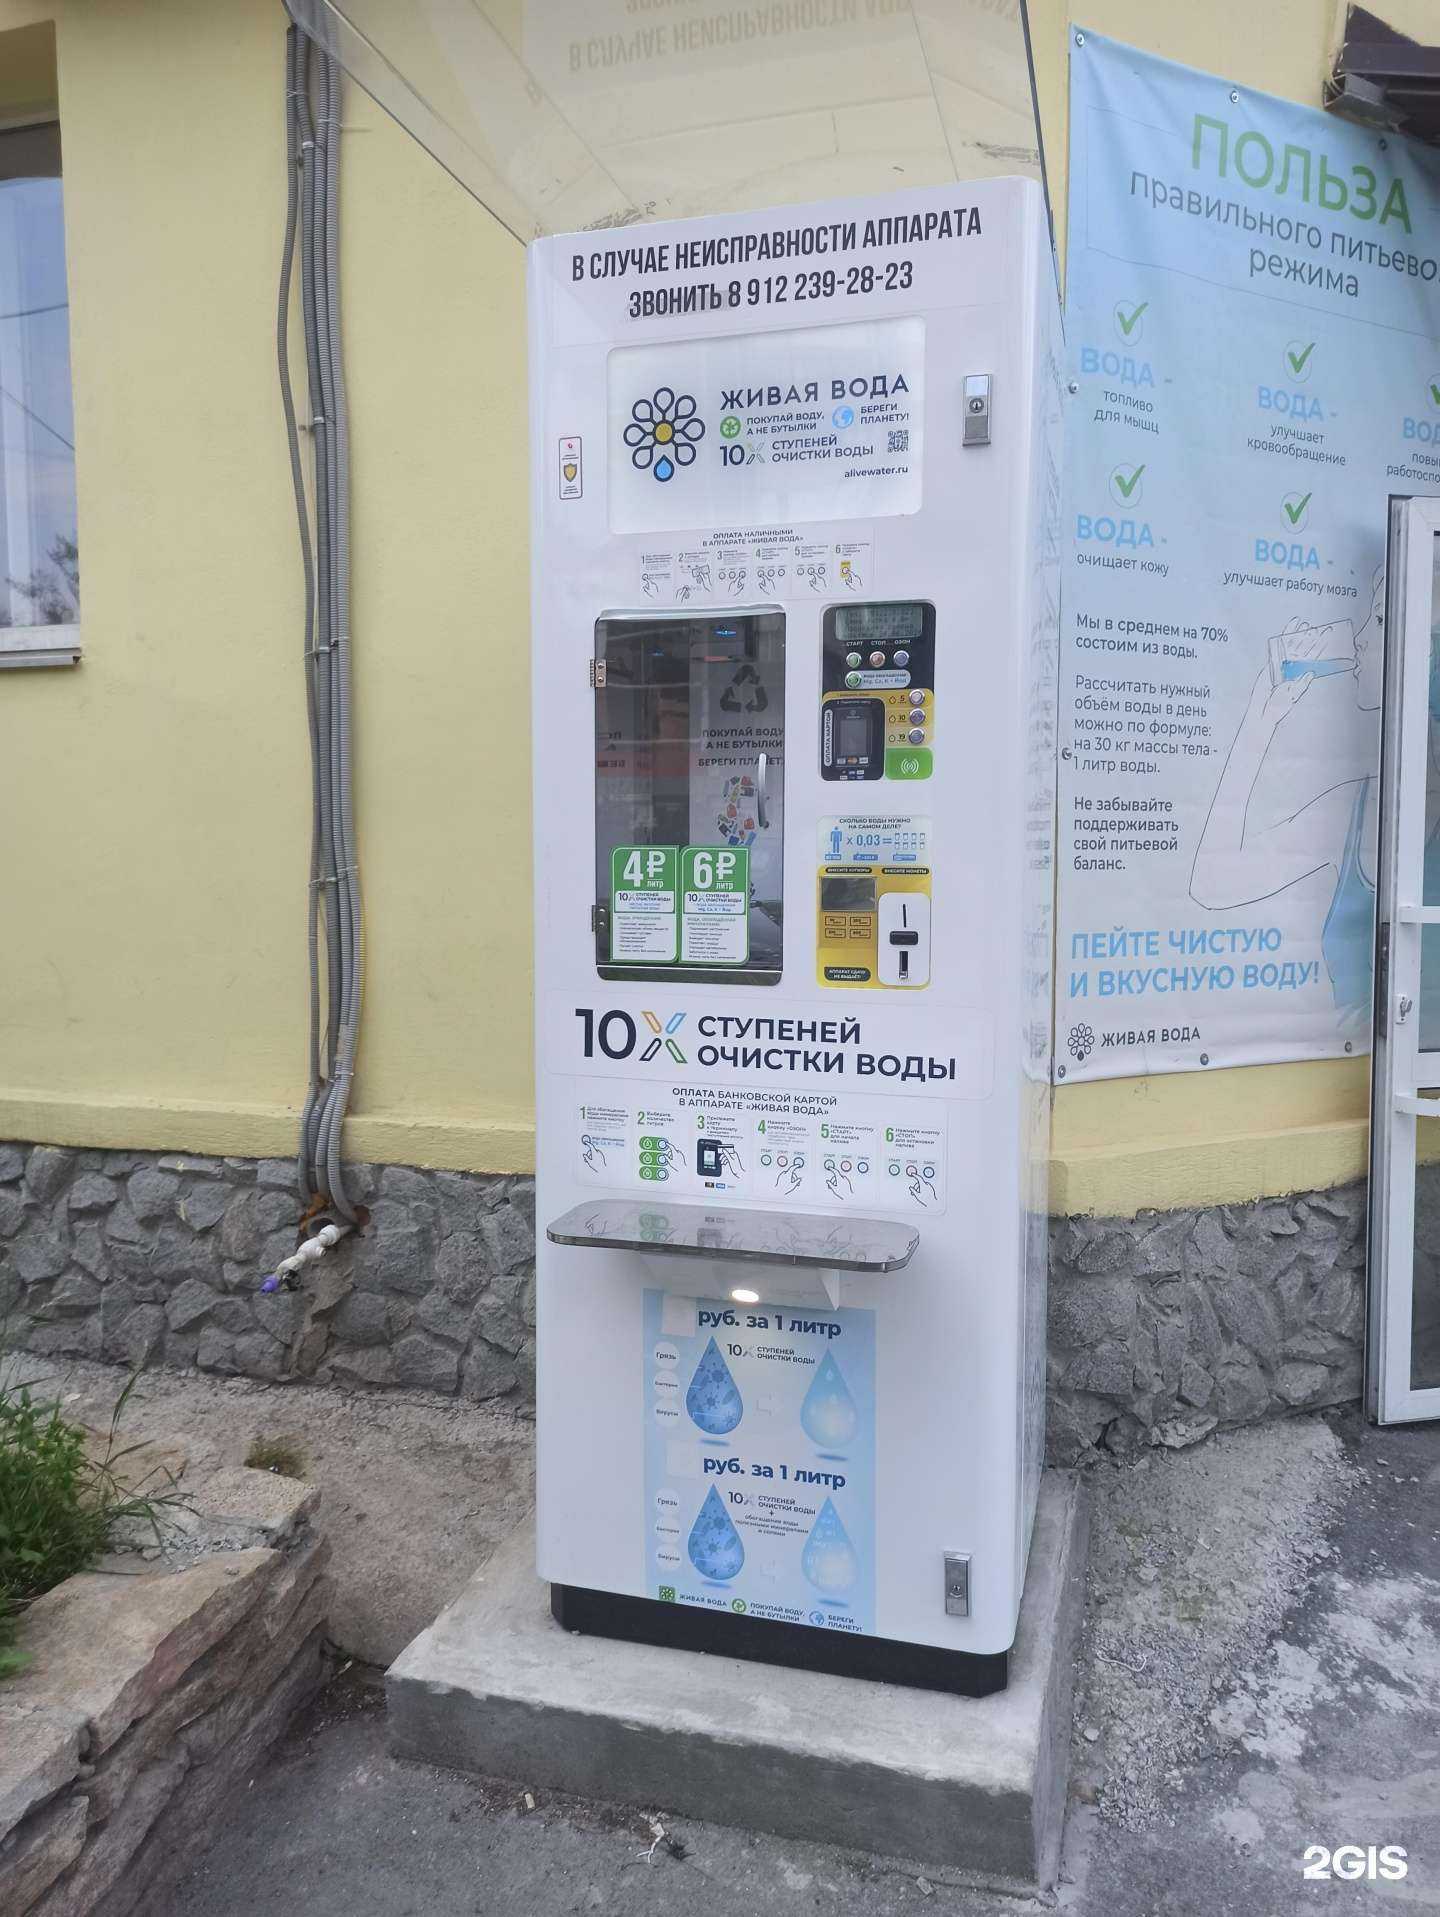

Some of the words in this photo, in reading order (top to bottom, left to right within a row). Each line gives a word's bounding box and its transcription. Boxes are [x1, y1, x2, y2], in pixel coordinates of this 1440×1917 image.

[1192, 113, 1412, 234] ПОЛЬЗА
[1131, 171, 1322, 249] правильного
[1331, 232, 1440, 282] питьево
[572, 254, 585, 282] В
[590, 244, 669, 279] СЛУЧАЕ
[675, 222, 857, 270] НЕИСПРАВНОСТИ
[862, 206, 982, 249] АППАРАТА
[1250, 248, 1359, 298] режима
[629, 282, 723, 319] ЗВОНИТЬ
[728, 280, 741, 309] 8
[747, 275, 788, 306] 912
[795, 260, 913, 302] 239-28-23
[1081, 347, 1155, 388] ВОДА
[720, 382, 818, 411] ЖИВАЯ
[832, 374, 910, 400] ВОДА
[860, 402, 898, 413] БЕРЕГИ
[1103, 390, 1153, 413] топливо
[1258, 386, 1324, 422] ВОДА
[747, 413, 794, 426] ПОКУПАЙ
[860, 413, 909, 425] ПЛАНЕТУ!
[1094, 408, 1121, 423] для
[1123, 414, 1159, 435] мышц
[747, 428, 754, 436] А
[756, 426, 768, 434] НЕ
[770, 422, 817, 433] БУТЫЛКИ
[1270, 424, 1326, 445] улучшает
[772, 435, 837, 450] СТУПЕНЕЙ
[772, 450, 832, 463] ОЧИСТКИ
[835, 446, 874, 458] ВОДЫ
[1248, 438, 1346, 466] кровообращение
[1412, 453, 1440, 467] повы
[844, 466, 908, 478] alivewater.ru
[745, 529, 793, 537] НАЛИЧНЫМИ
[1077, 514, 1154, 549] ВОДА
[708, 538, 746, 546] АППАРАТЕ
[1255, 539, 1320, 571] ВОДА
[1077, 551, 1138, 572] очищает
[1140, 560, 1169, 578] кожу
[1223, 570, 1283, 590] улучшает
[1286, 576, 1324, 596] работу
[1327, 584, 1358, 598] мозга
[1077, 613, 1100, 629] Мы
[1105, 618, 1113, 630] в
[1118, 619, 1180, 637] среднем
[1183, 627, 1198, 640] на
[1201, 627, 1228, 642] 70%
[1076, 635, 1138, 652] состоим
[1142, 641, 1159, 654] из
[1163, 644, 1197, 659] воды.
[1076, 675, 1156, 694] Рассчитать
[1160, 684, 1210, 699] нужный
[1075, 696, 1120, 711] объём
[1125, 701, 1161, 716] воды
[1167, 704, 1173, 714] в
[1176, 705, 1207, 719] день
[703, 727, 752, 737] ПОКУПАЙ
[1074, 719, 1123, 732] можно
[1128, 721, 1145, 732] по
[1149, 719, 1212, 738] формуле:
[732, 740, 782, 748] БУТЫЛКИ
[1074, 740, 1091, 751] на
[1094, 737, 1111, 751] 30
[1116, 740, 1130, 752] кг
[1134, 741, 1179, 754] массы
[1182, 743, 1210, 756] тела
[698, 758, 736, 766] БЕРЕГИ
[1082, 759, 1116, 774] литр
[1120, 762, 1160, 774] воды.
[1074, 796, 1092, 810] Не
[1096, 797, 1173, 812] забывайте
[1074, 817, 1179, 833] поддерживать
[856, 834, 880, 847] 0,03
[1074, 836, 1106, 851] свой
[1111, 837, 1178, 851] питьевой
[1074, 855, 1126, 871] баланс.
[647, 879, 664, 888] литр
[716, 881, 733, 890] литр
[1071, 925, 1160, 959] ПЕЙТЕ
[1168, 927, 1281, 955] ЧИСТУЮ
[1070, 971, 1088, 998] И
[1098, 964, 1234, 997] ВКУСНУЮ
[1242, 961, 1319, 990] ВОДУ!
[697, 1015, 861, 1045] СТУПЕНЕЙ
[1101, 1029, 1156, 1048] ЖИВАЯ
[1161, 1026, 1200, 1042] ВОДА
[697, 1045, 844, 1074] ОЧИСТКИ
[856, 1053, 956, 1082] ВОДЫ
[672, 1087, 715, 1098] ОПЛАТА
[718, 1090, 791, 1103] БАНКОВСКОЙ
[794, 1095, 837, 1107] КАРТОЙ
[580, 1106, 586, 1119] 1
[679, 1098, 685, 1107] В
[688, 1099, 743, 1112] АППАРАТЕ
[746, 1102, 790, 1114] «ЖИВАЯ
[793, 1105, 829, 1117] ВОДА»
[637, 1111, 645, 1125] 2
[698, 1115, 705, 1129] 3
[758, 1120, 766, 1134] 4
[821, 1123, 829, 1138] 5
[886, 1128, 894, 1142] 6
[698, 1309, 740, 1328] руб.
[746, 1315, 769, 1329] за
[775, 1315, 783, 1330] 1
[789, 1319, 842, 1339] литр
[757, 1345, 795, 1356] СТУПЕНЕЙ
[757, 1353, 790, 1362] ОЧИСТКИ
[793, 1356, 815, 1365] ВОДЫ
[703, 1457, 745, 1476] руб.
[751, 1463, 773, 1478] за
[780, 1465, 788, 1480] 1
[794, 1470, 846, 1490] литр
[758, 1495, 796, 1505] СТУПЕНЕЙ
[758, 1502, 792, 1511] ОЧИСТКИ
[794, 1506, 816, 1515] ВОДЫ
[680, 1594, 705, 1603] ЖИВАЯ
[707, 1598, 727, 1606] ВОДА
[750, 1603, 784, 1612] ПОКУПАЙ
[768, 1612, 800, 1622] БУТЫЛКИ
[828, 1614, 854, 1624] БЕРЕГИ
